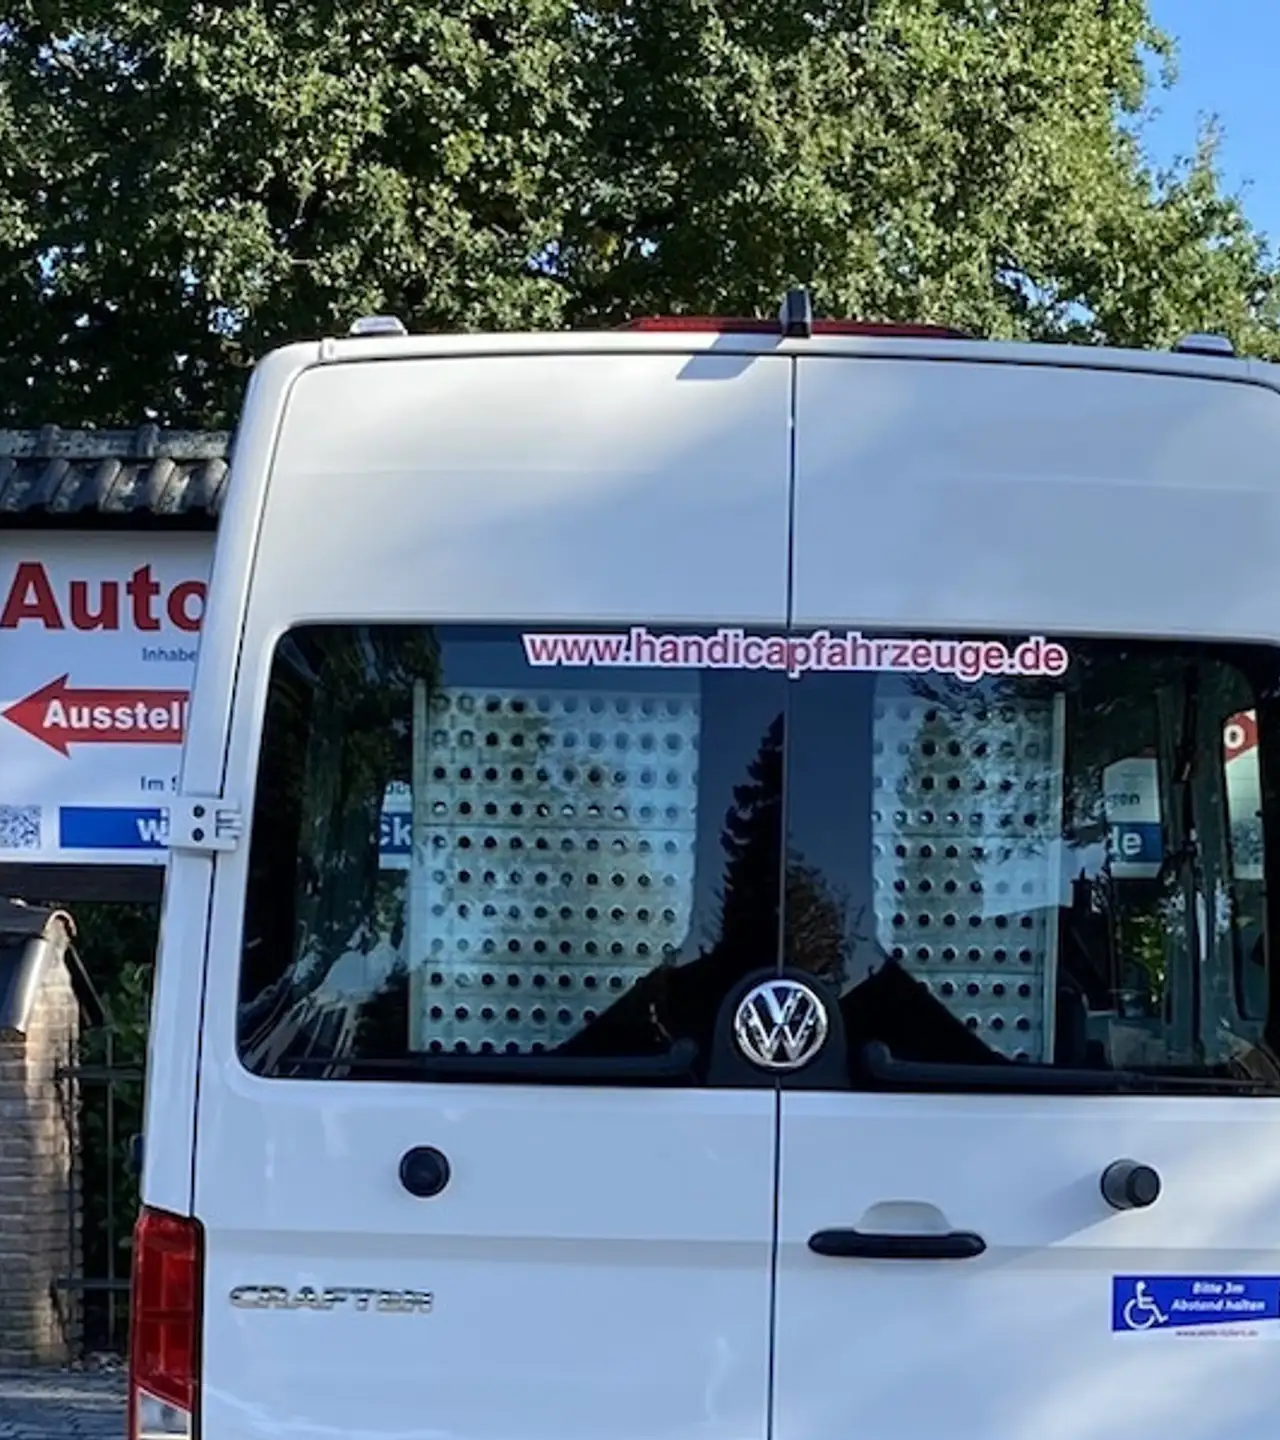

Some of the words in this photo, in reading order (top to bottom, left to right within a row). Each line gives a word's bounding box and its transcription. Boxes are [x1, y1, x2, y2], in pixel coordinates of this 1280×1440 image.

[525, 628, 1066, 679] www.handicapfahrzeuge.de
[141, 775, 165, 791] Im
[229, 1281, 435, 1315] CRAFTER
